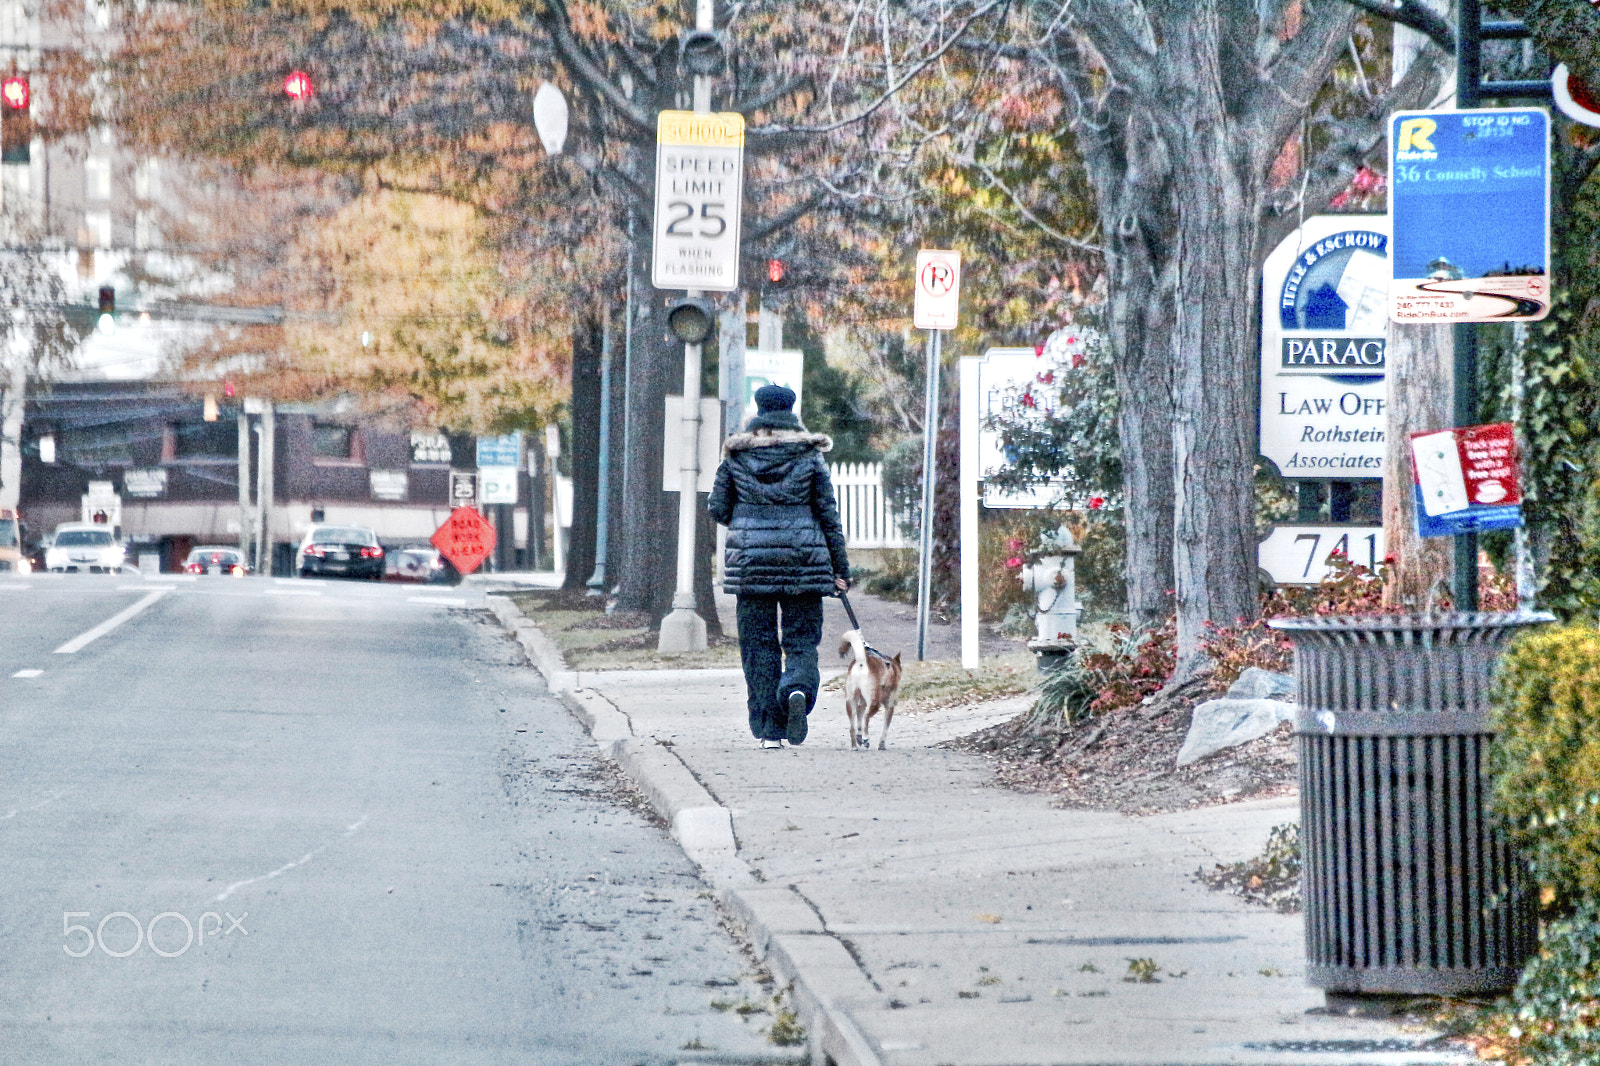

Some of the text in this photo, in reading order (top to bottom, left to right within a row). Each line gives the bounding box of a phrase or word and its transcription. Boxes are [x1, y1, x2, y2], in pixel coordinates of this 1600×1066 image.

[1462, 115, 1494, 127] STOP
[668, 122, 734, 143] SCHOOL
[666, 156, 734, 175] SPEED
[1396, 164, 1541, 183] 36 Connelly School
[672, 179, 724, 195] LIMIT
[665, 201, 727, 239] 25
[678, 248, 712, 259] WHEN
[665, 264, 724, 277] FLASHING
[1282, 265, 1307, 308] TITLE
[1316, 232, 1382, 257] ESCROW
[1287, 340, 1384, 365] PARAG
[1278, 392, 1333, 415] LAW
[1300, 425, 1385, 443] Rothstein
[1285, 452, 1383, 468] Associates
[455, 484, 473, 498] 25
[451, 519, 480, 530] ROAD
[450, 545, 484, 557] AHEAD
